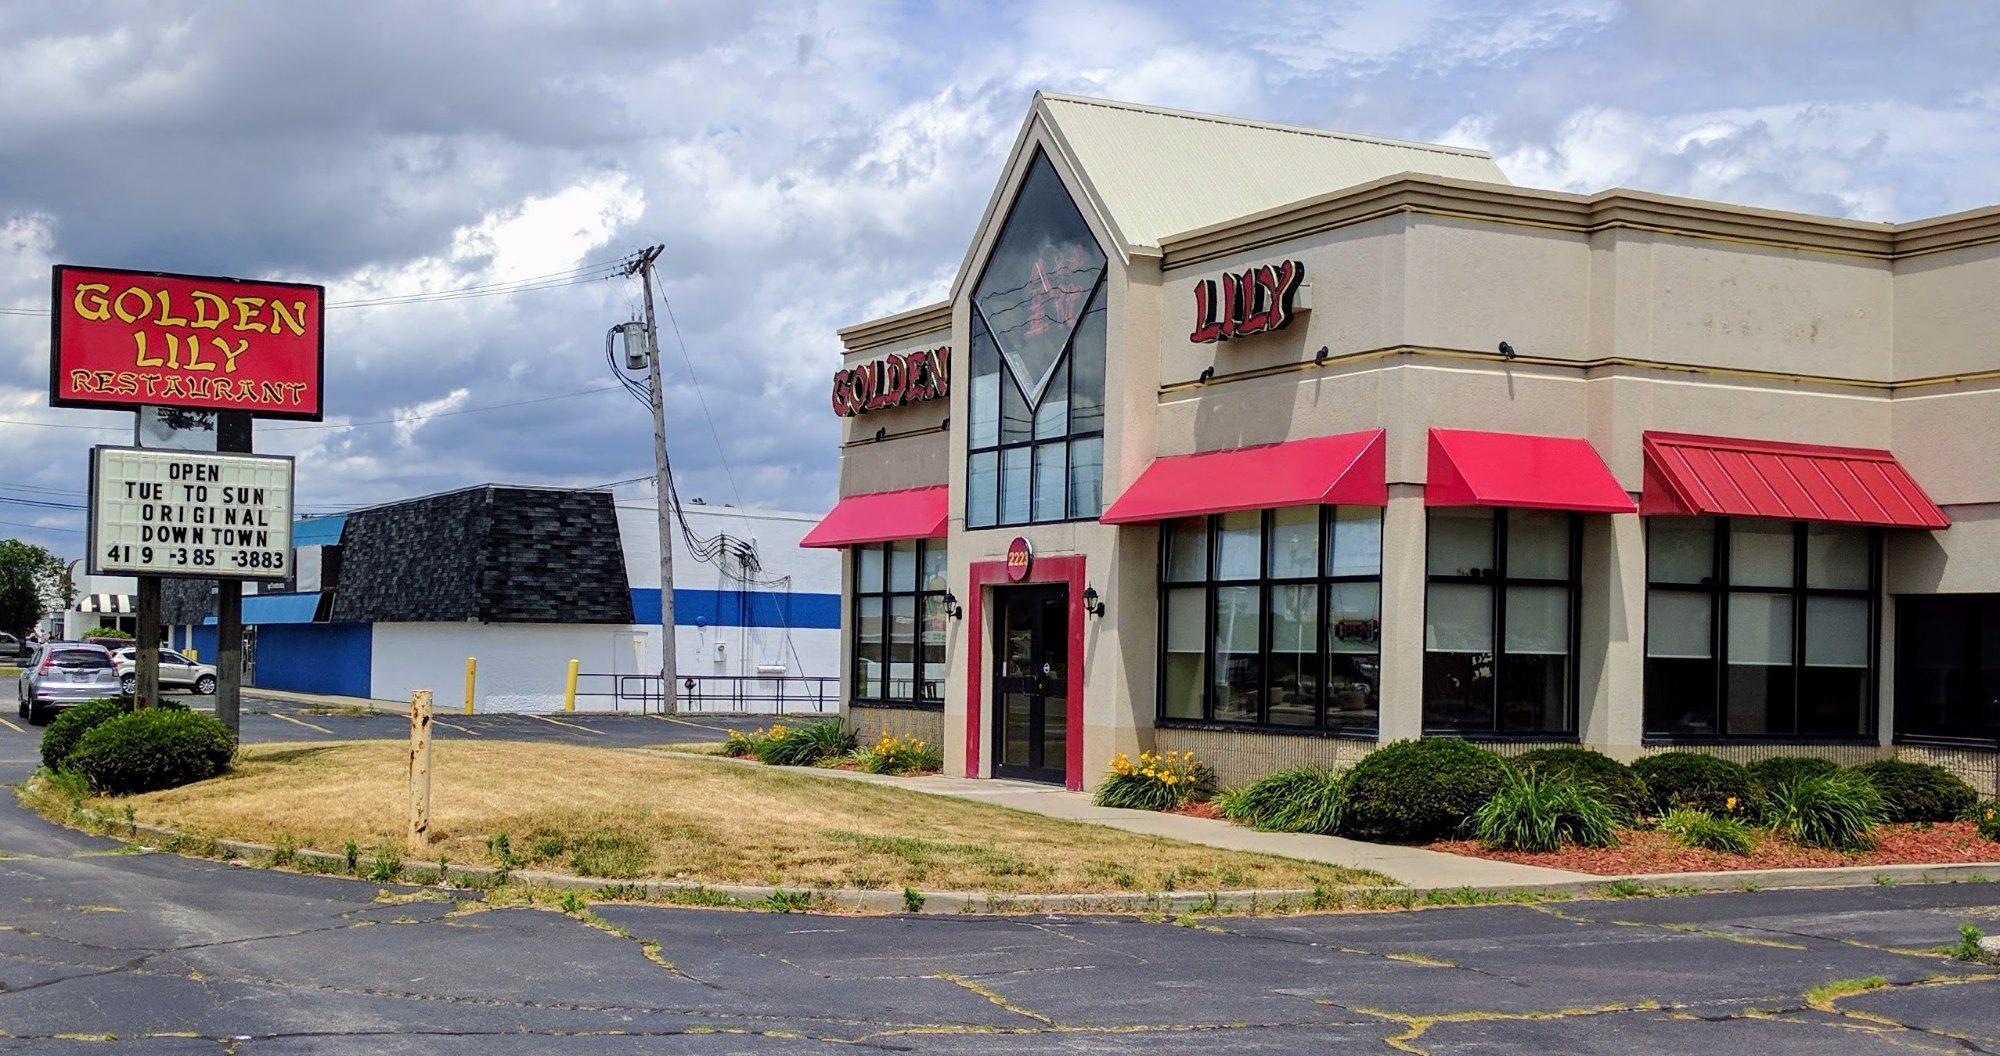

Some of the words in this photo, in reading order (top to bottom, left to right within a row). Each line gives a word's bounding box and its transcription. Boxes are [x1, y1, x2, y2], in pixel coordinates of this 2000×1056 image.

[73, 283, 307, 336] GOLDEN
[1190, 259, 1305, 343] LILY
[133, 330, 250, 373] LILY
[70, 369, 306, 405] RESTAURANT
[832, 346, 950, 417] GOLDEN
[169, 462, 220, 482] OPEN
[125, 481, 163, 500] TUE
[184, 485, 207, 503] TO
[223, 486, 265, 505] SUN
[142, 504, 269, 527] ORIGINAL
[1008, 551, 1029, 567] 2223
